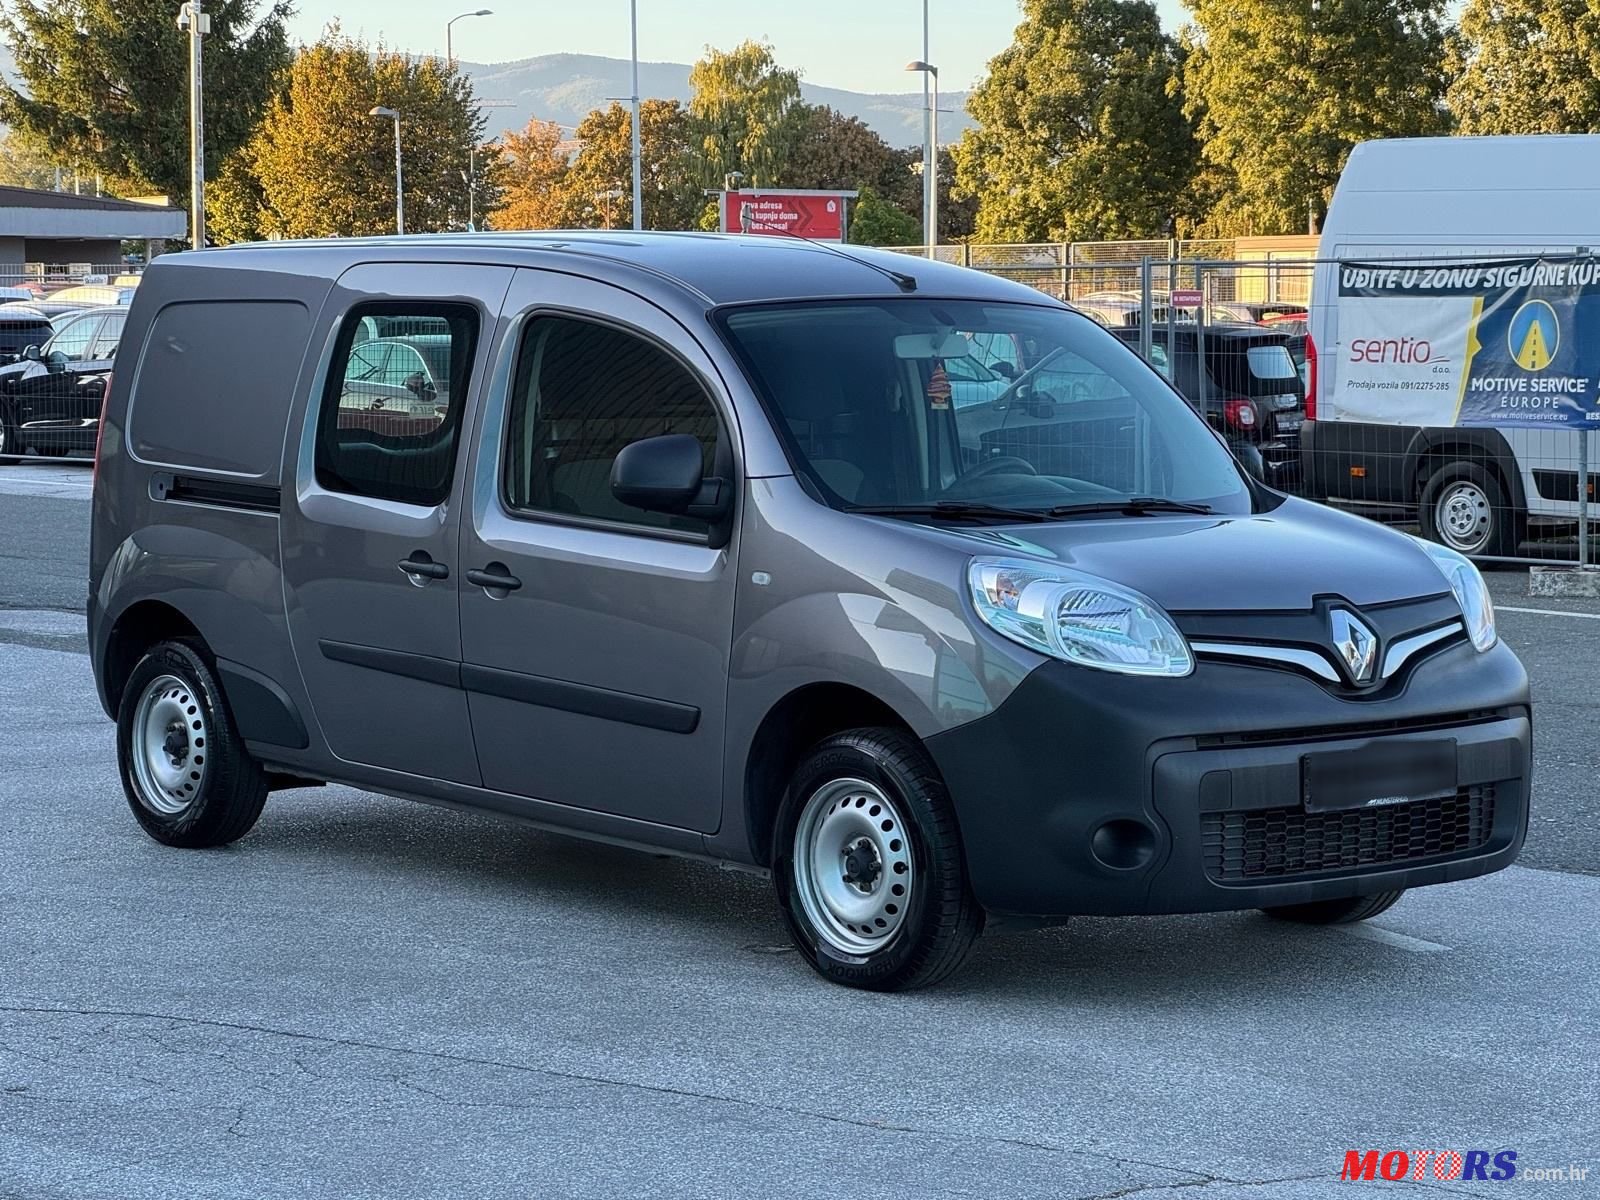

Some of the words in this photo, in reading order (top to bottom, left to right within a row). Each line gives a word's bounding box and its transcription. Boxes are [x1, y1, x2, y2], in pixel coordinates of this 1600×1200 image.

[740, 201, 758, 209] Nva
[759, 201, 783, 209] adresa
[755, 211, 778, 221] kupnju
[1342, 269, 1400, 289] UĐITE
[1401, 269, 1419, 289] U
[1419, 268, 1481, 289] ZONU
[1483, 264, 1566, 288] SIGURNE
[1350, 336, 1431, 363] sentio
[1432, 366, 1451, 374] d.o.o.
[1347, 380, 1376, 391] Prodaja
[1377, 381, 1399, 390] vozila
[1400, 381, 1450, 391] 091/2275-285
[1471, 378, 1527, 392] MOTIVE
[1500, 396, 1559, 409] EUROPE
[1490, 412, 1568, 421] www.motiveservice.eu
